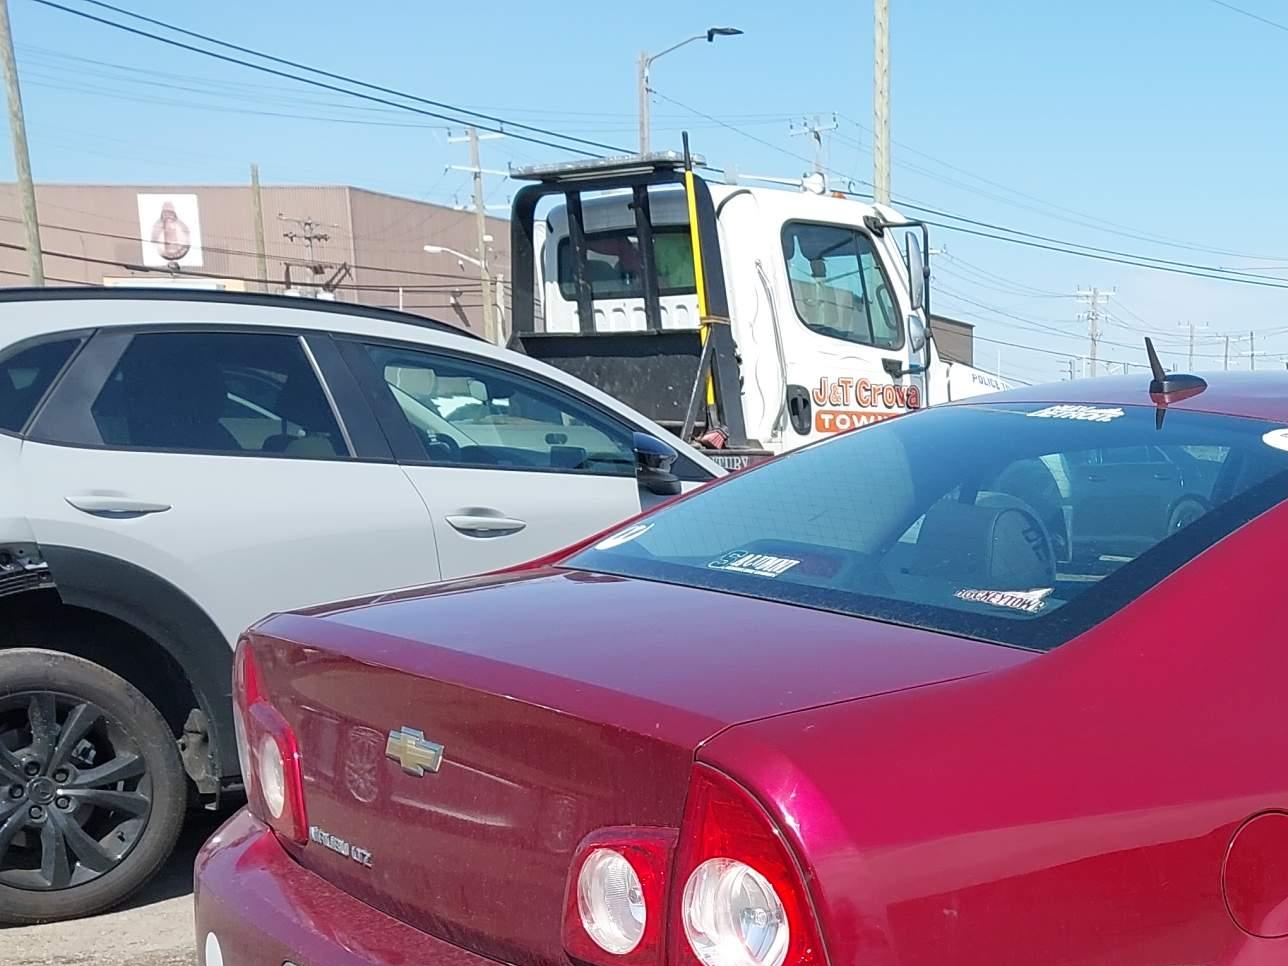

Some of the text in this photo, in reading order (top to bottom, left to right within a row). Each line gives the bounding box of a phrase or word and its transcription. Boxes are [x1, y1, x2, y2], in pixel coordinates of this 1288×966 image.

[971, 373, 1000, 390] POLICE
[812, 376, 920, 410] J&T Crova
[820, 413, 893, 430] TOW
